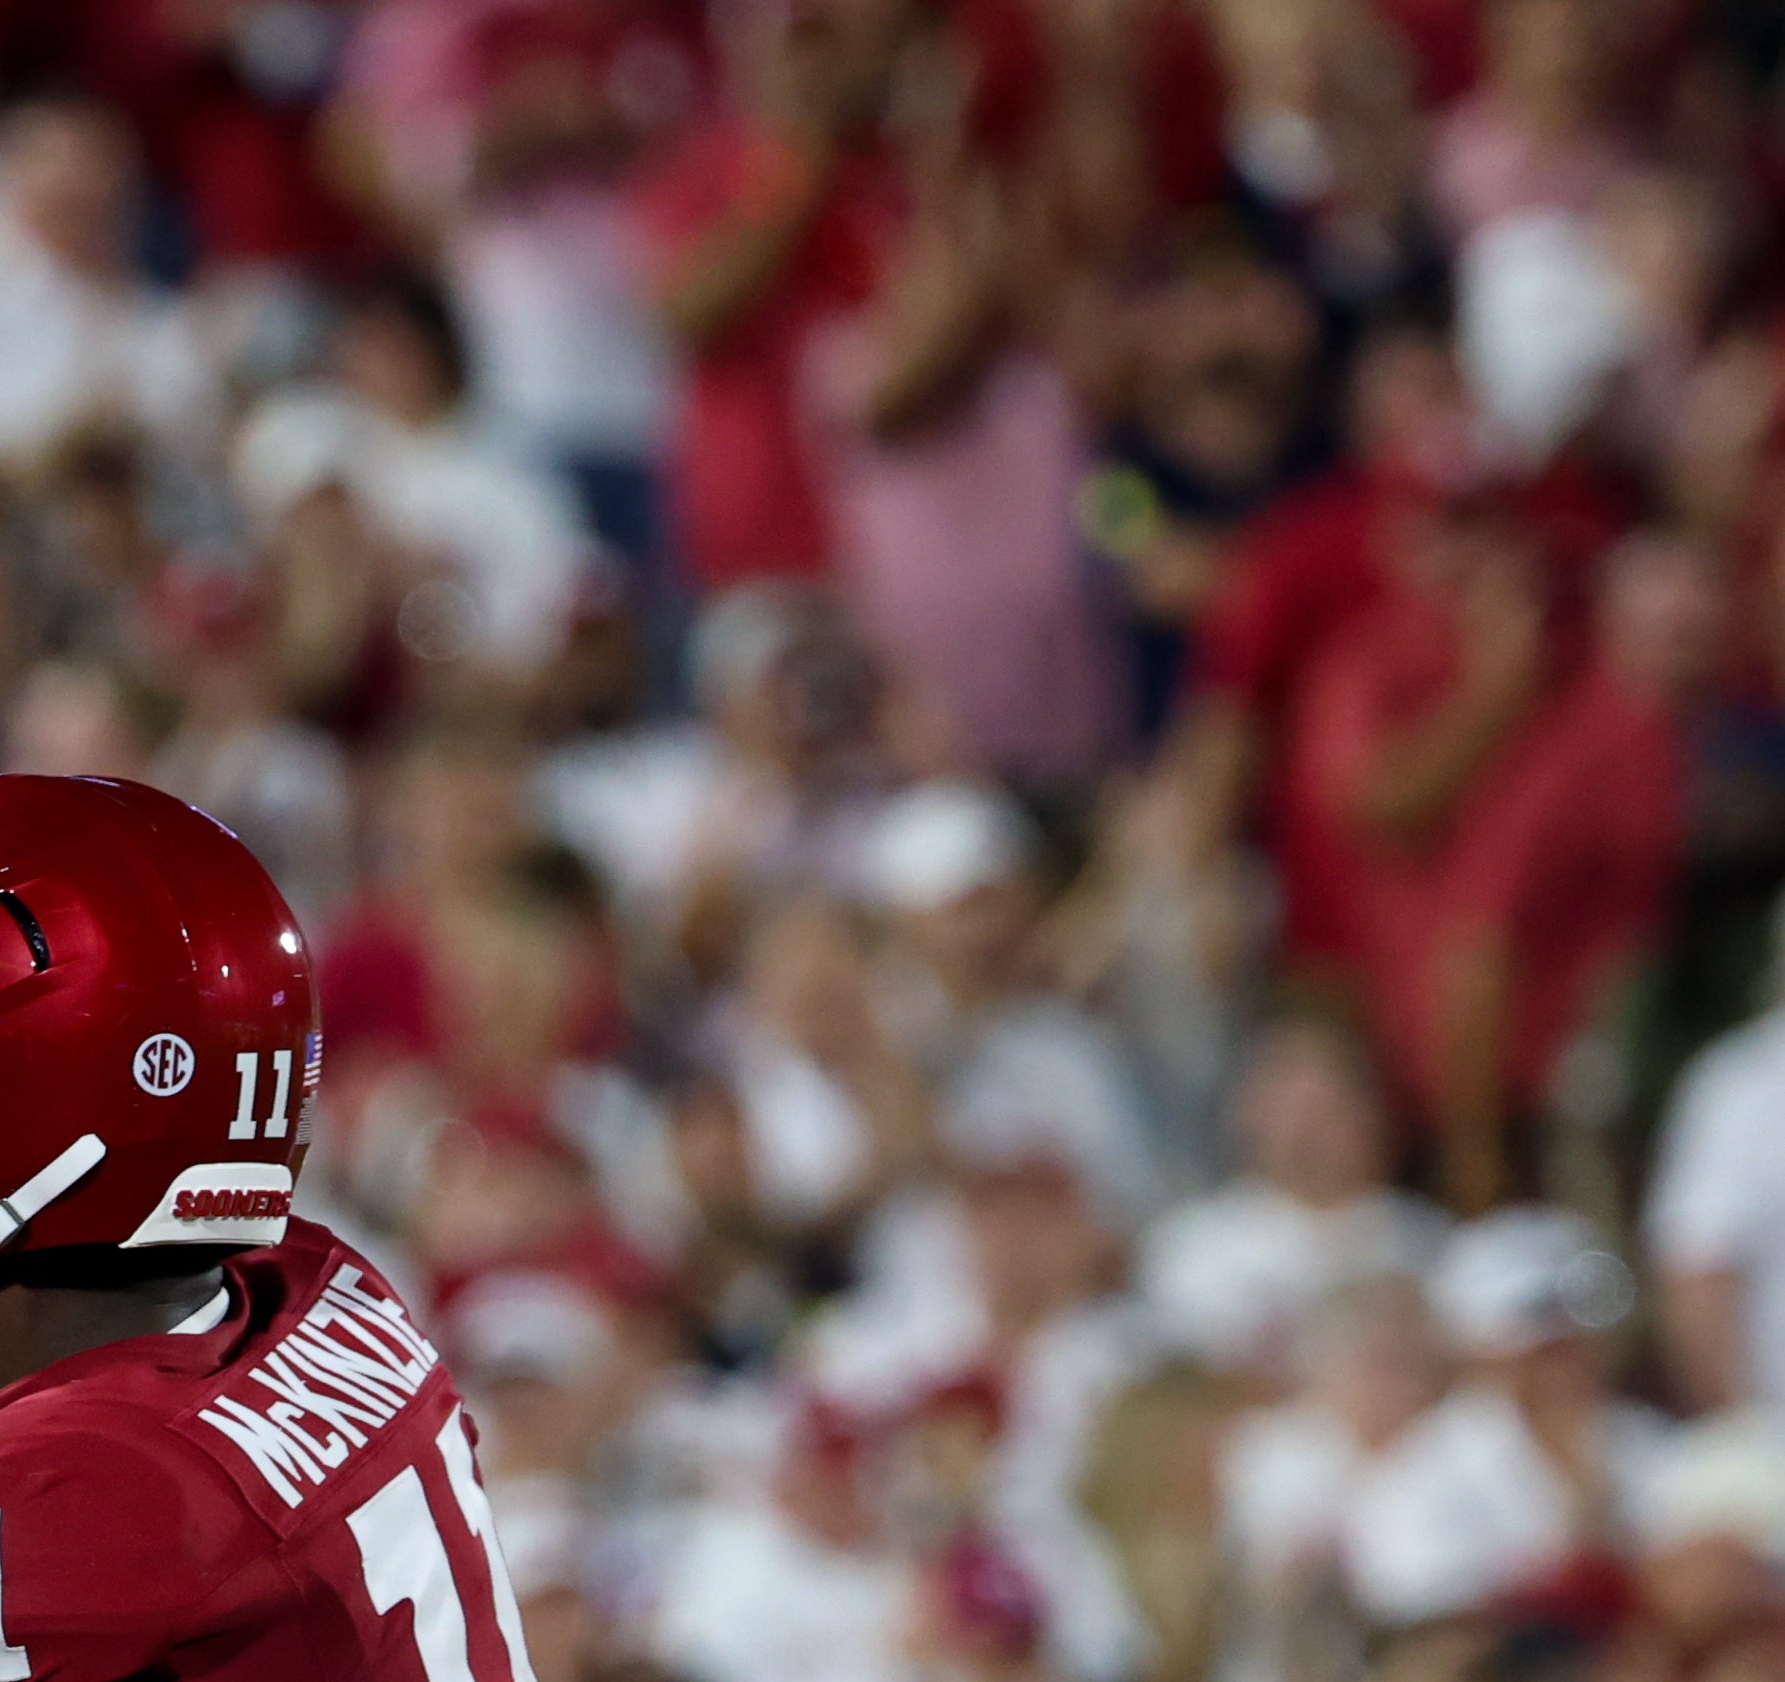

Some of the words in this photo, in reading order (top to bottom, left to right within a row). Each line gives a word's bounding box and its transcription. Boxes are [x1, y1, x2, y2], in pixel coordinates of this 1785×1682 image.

[140, 1038, 188, 1090] SEC
[228, 1049, 292, 1140] 11
[196, 1262, 440, 1510] McKINZIE
